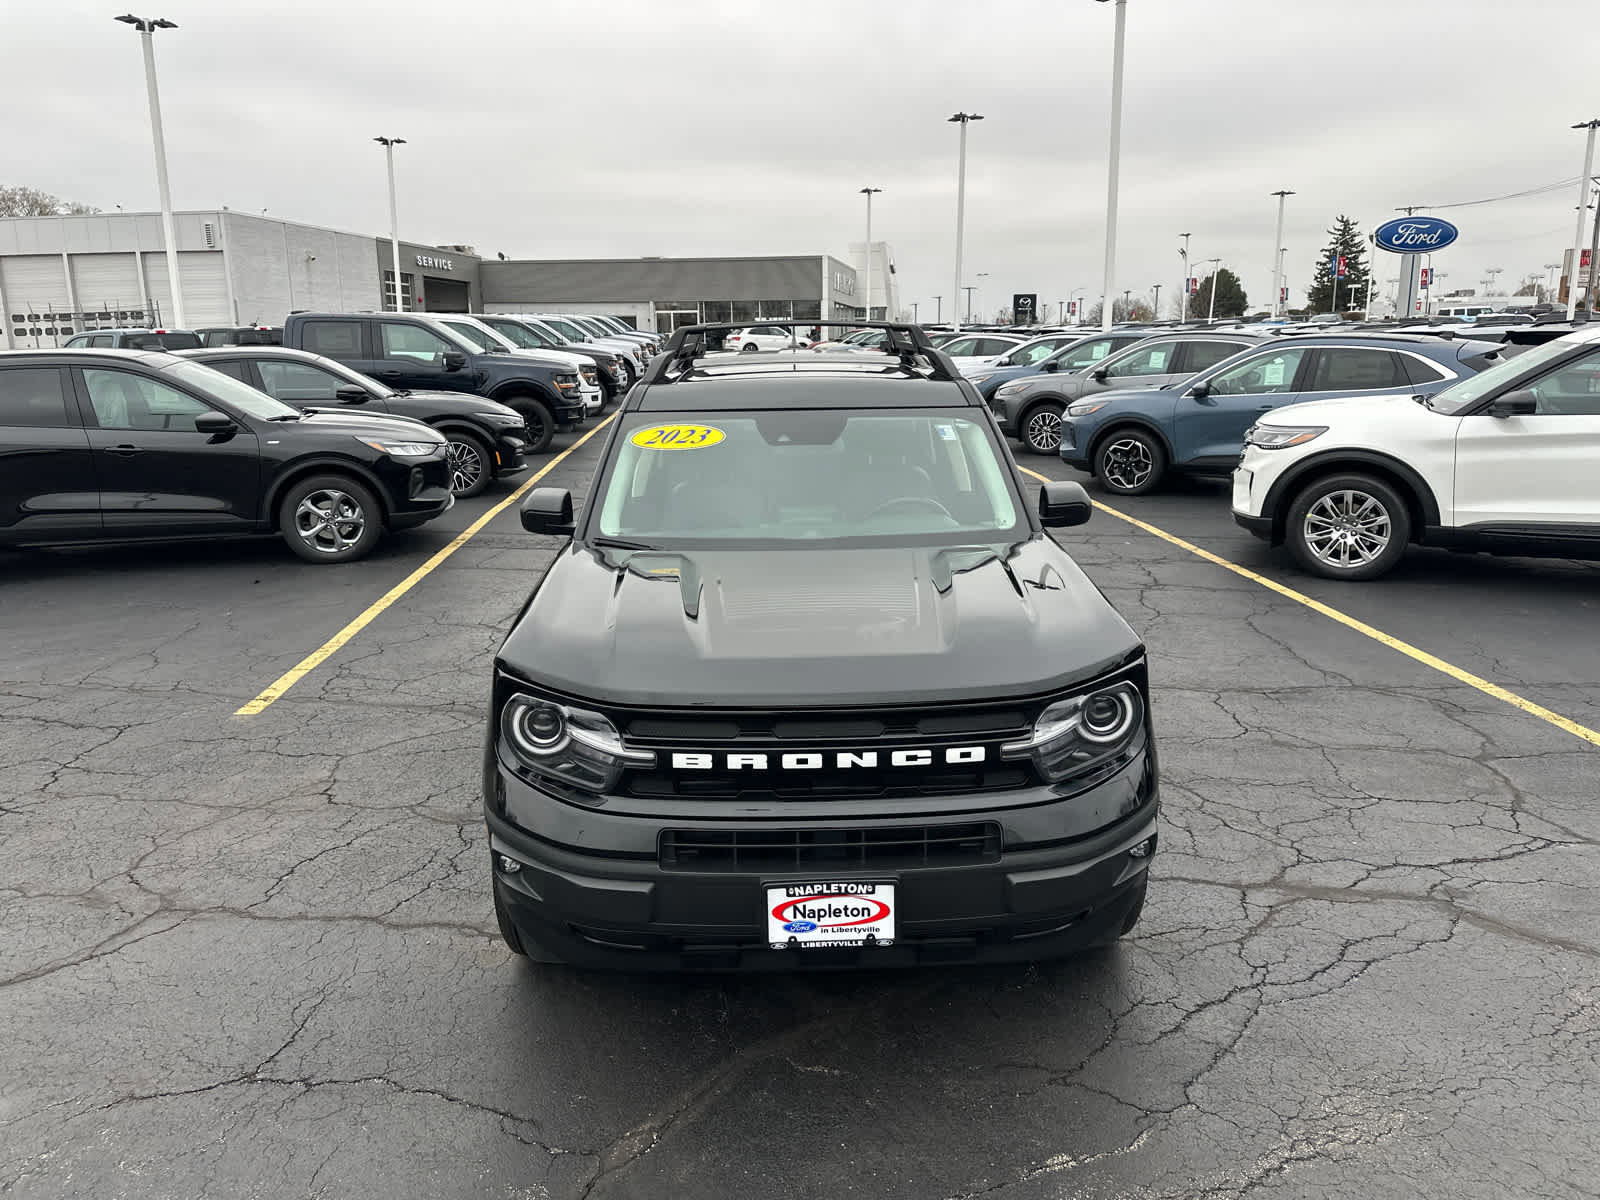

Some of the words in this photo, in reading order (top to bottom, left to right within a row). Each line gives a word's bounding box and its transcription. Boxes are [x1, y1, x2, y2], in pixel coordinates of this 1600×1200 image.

[1392, 223, 1442, 245] Ford
[417, 255, 453, 270] SERVICE
[643, 429, 712, 445] 2023
[672, 746, 986, 770] BRONCO
[794, 883, 868, 897] NAPLETON
[792, 904, 871, 922] Napleton
[789, 921, 811, 932] Ford
[831, 926, 881, 934] Libertyville
[801, 940, 864, 948] LIBERTYVILLE
